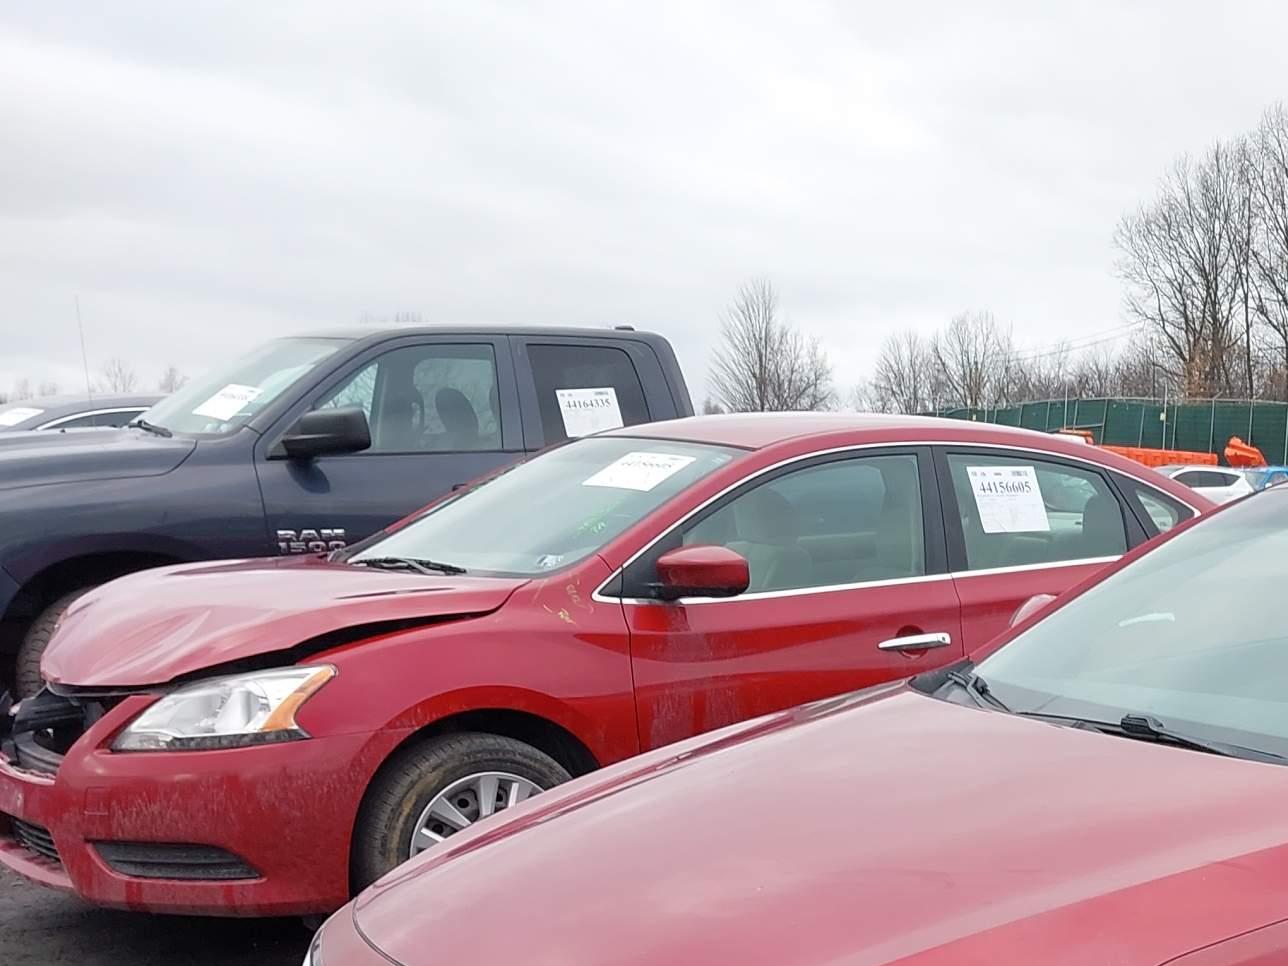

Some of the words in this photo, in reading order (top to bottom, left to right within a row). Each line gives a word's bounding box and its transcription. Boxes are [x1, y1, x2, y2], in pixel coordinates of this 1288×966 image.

[565, 398, 611, 409] 44164335
[979, 481, 1032, 494] 44156605
[277, 529, 345, 541] RAM
[278, 541, 346, 553] 1500
